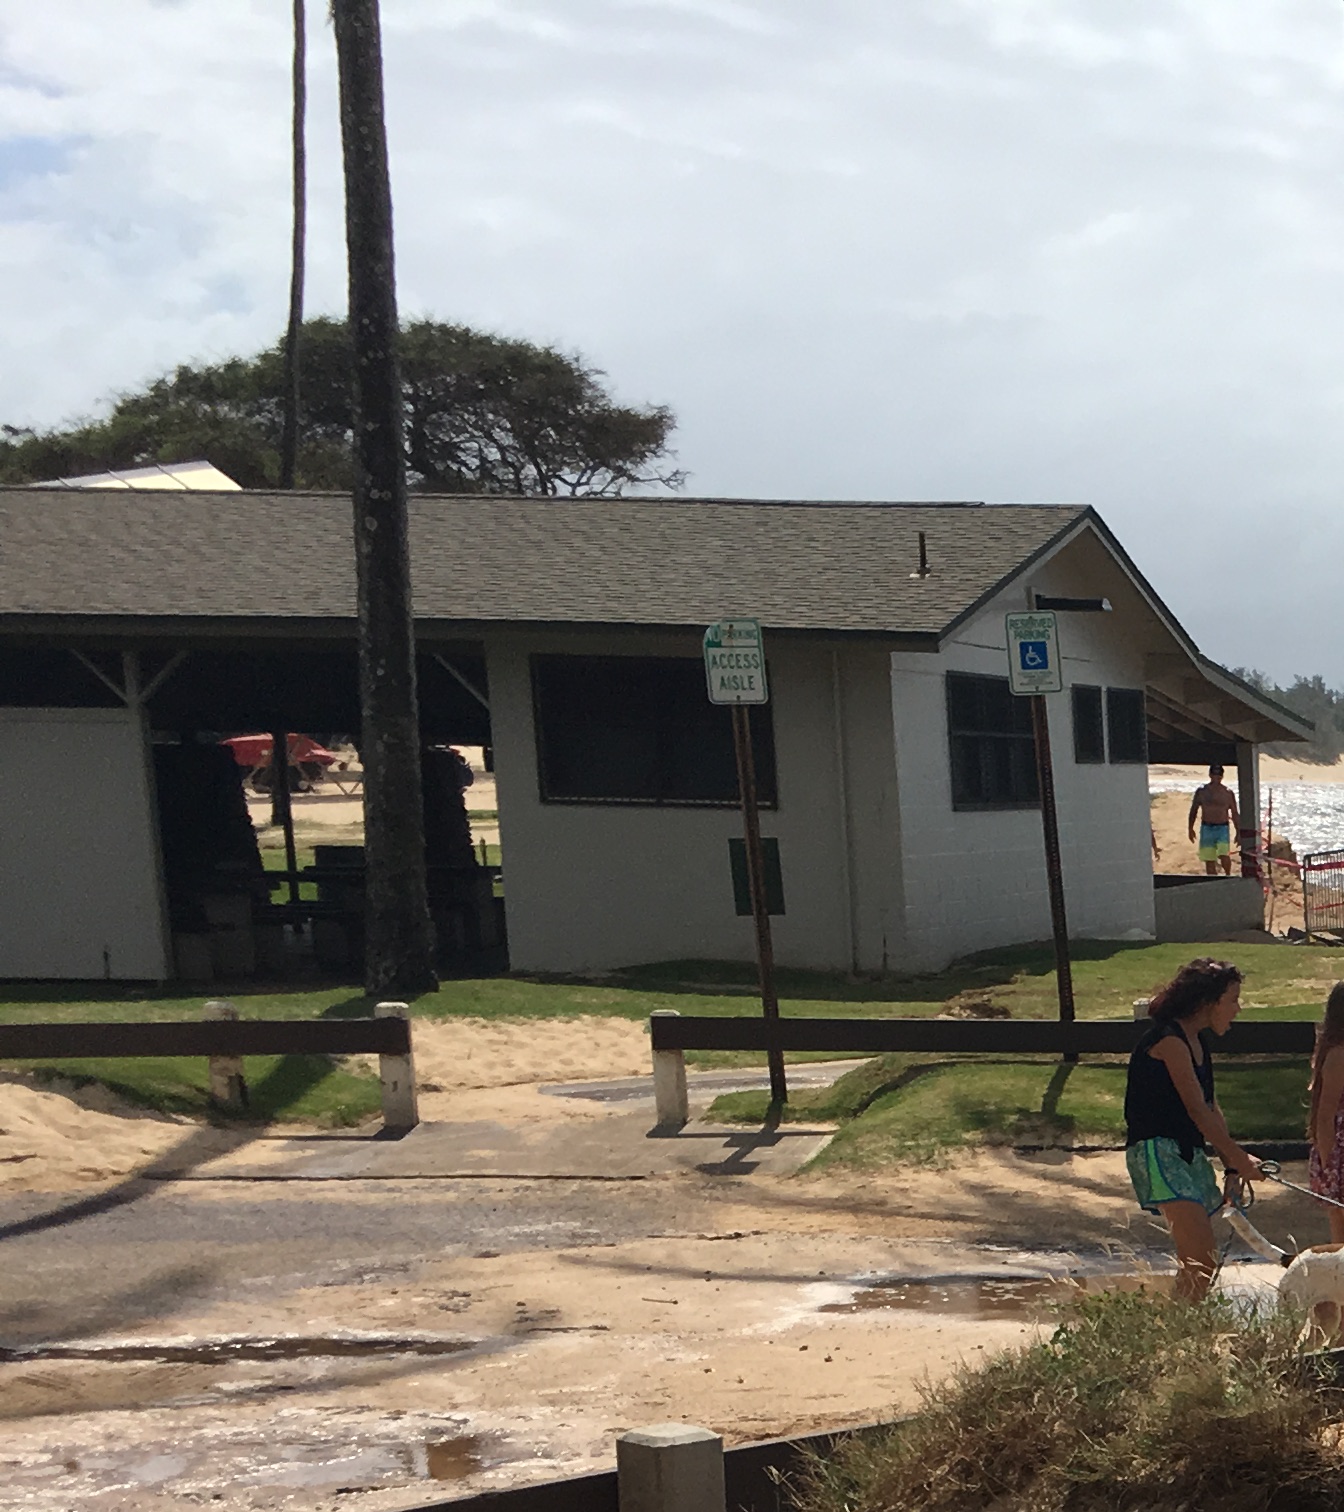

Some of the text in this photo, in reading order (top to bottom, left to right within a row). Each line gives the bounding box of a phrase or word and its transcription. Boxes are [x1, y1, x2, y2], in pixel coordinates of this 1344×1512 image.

[1009, 618, 1053, 629] RESERVED
[1014, 629, 1050, 640] PARKING
[711, 653, 760, 669] ACCESS
[720, 675, 755, 691] AISLE
